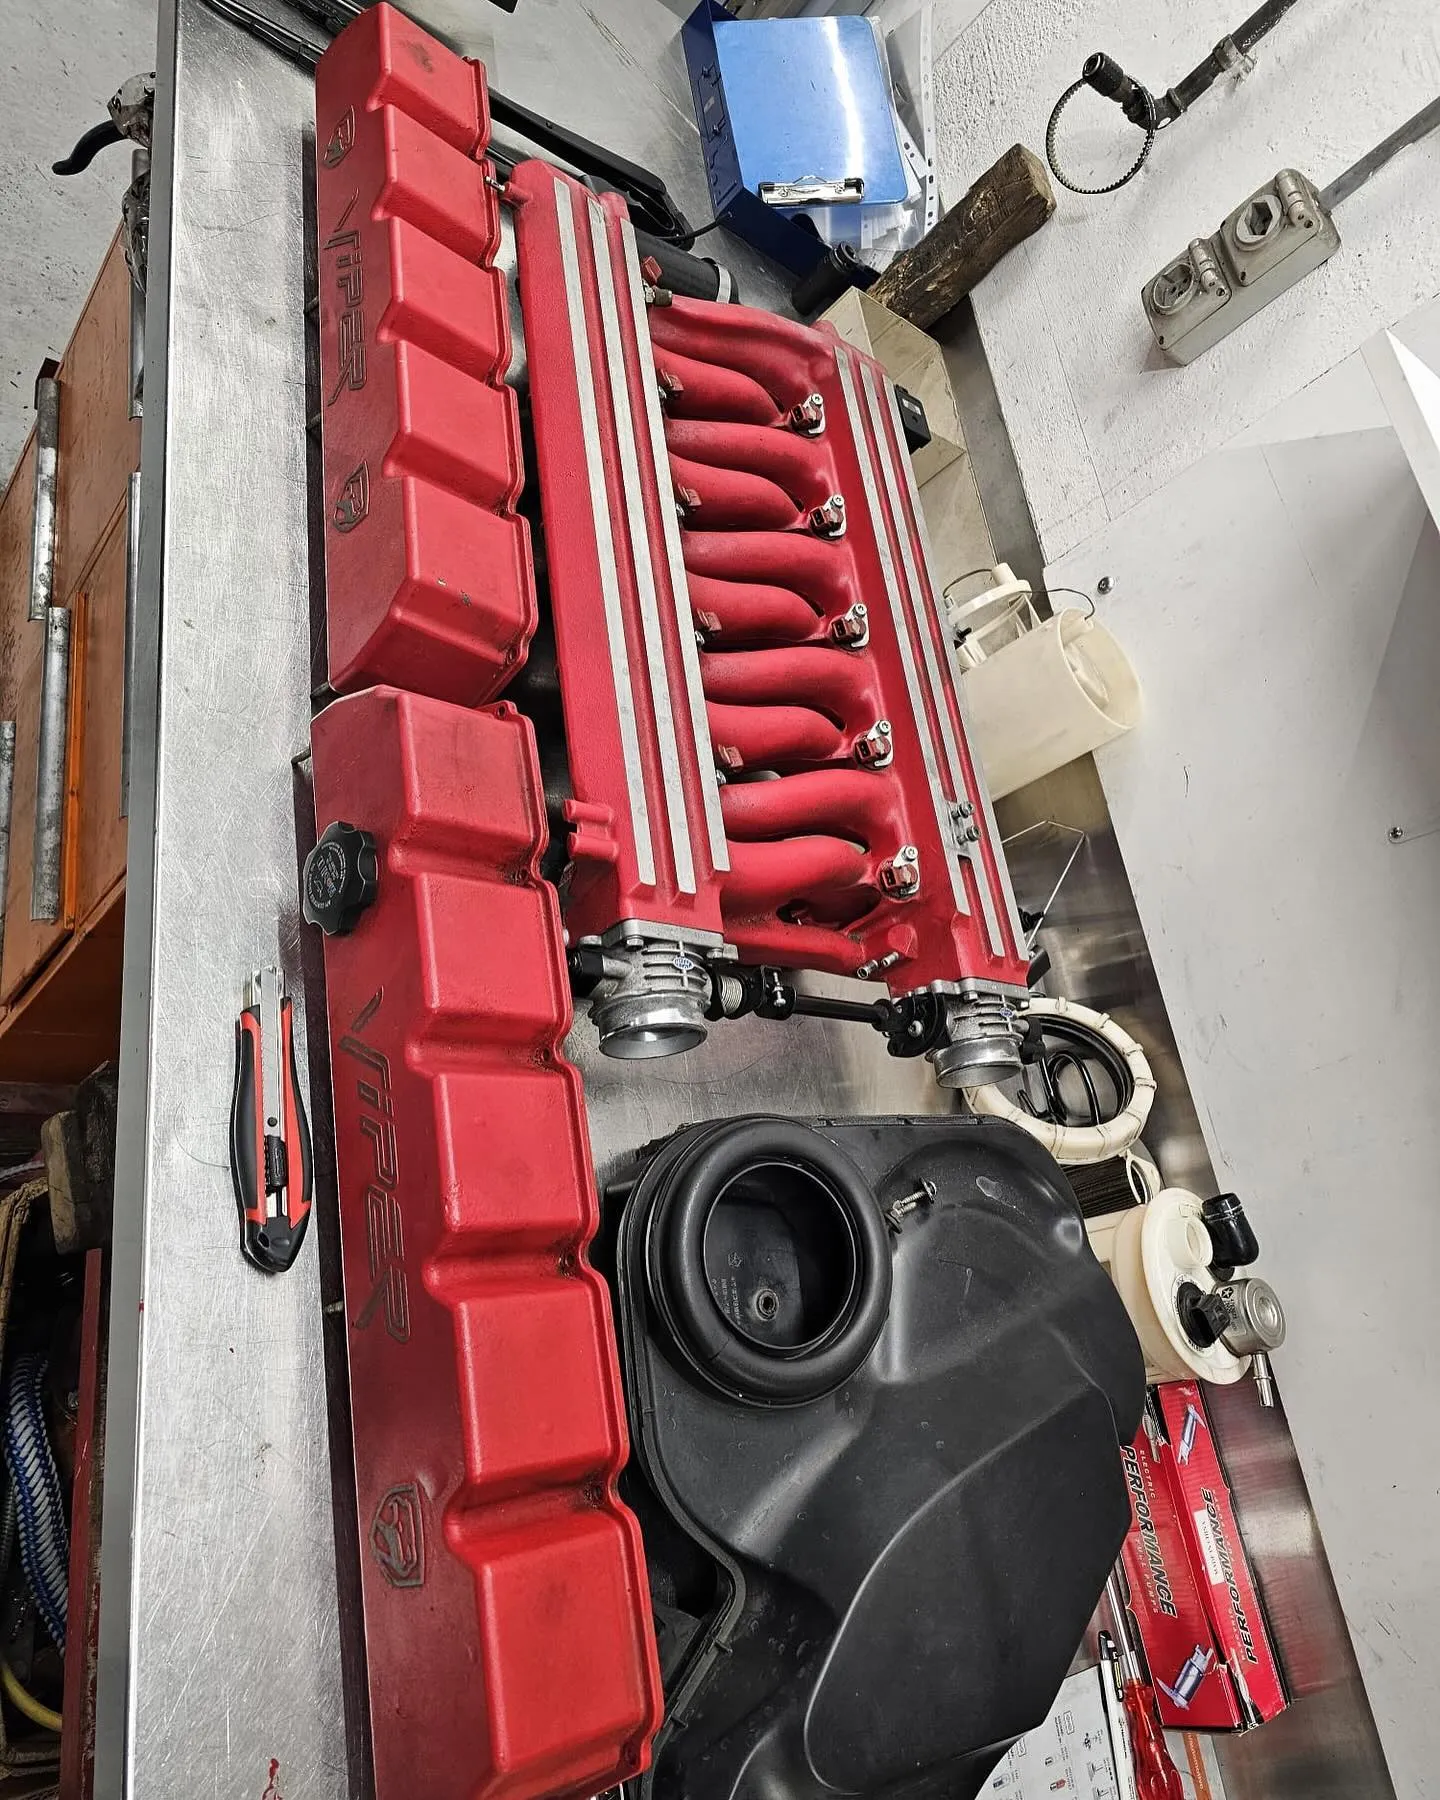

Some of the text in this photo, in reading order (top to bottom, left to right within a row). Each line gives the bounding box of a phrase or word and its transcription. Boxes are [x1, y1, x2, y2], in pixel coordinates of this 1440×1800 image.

[1139, 1450, 1156, 1499] ELECTRIC
[1120, 1445, 1178, 1618] PERFORMANCE
[1201, 1487, 1259, 1664] PERFORMANCE
[1143, 1574, 1159, 1614] PUMPS
